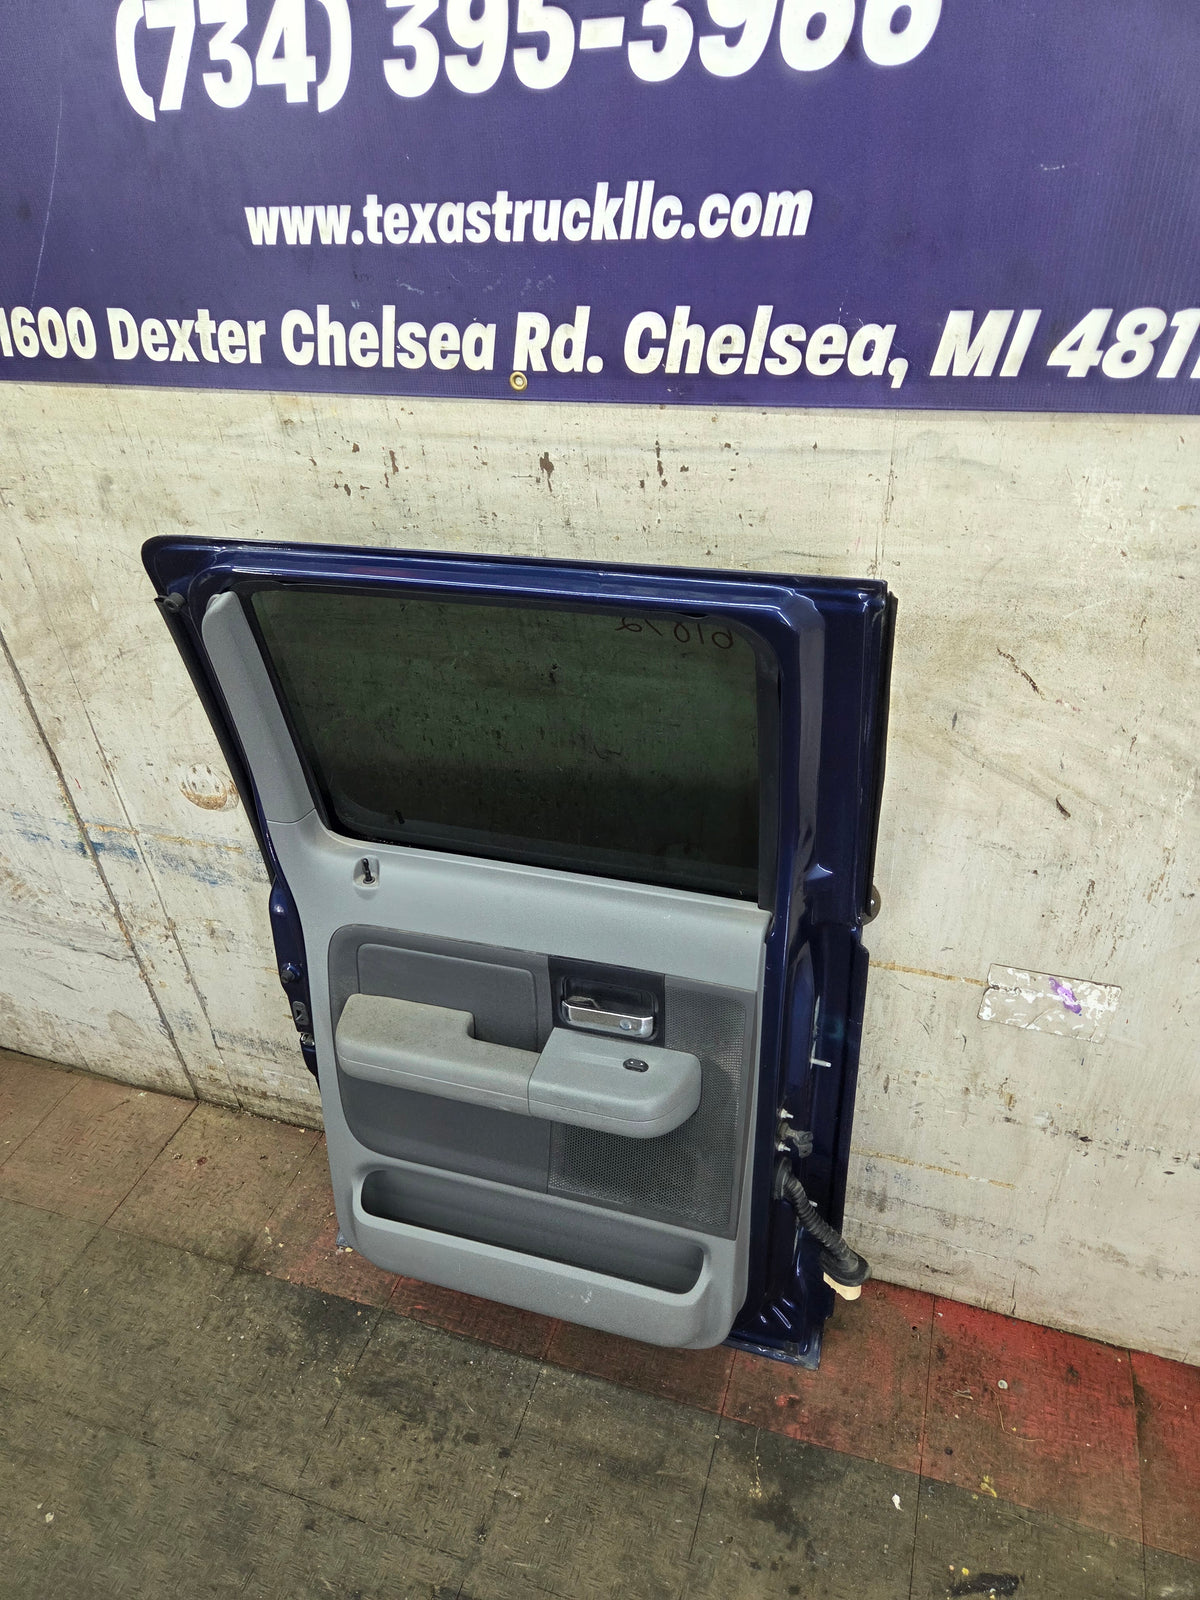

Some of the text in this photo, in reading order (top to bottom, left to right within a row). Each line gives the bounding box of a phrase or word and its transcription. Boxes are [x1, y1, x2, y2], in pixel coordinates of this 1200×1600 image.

[115, 0, 353, 122] (734)
[244, 180, 813, 246] www.texastruckllc.com
[106, 307, 267, 364] Dexter
[280, 304, 497, 371] Chelsea
[512, 305, 604, 374] Rd.
[623, 304, 909, 389] Chelsea,
[929, 309, 1042, 377] MI
[1046, 307, 1200, 379] 481
